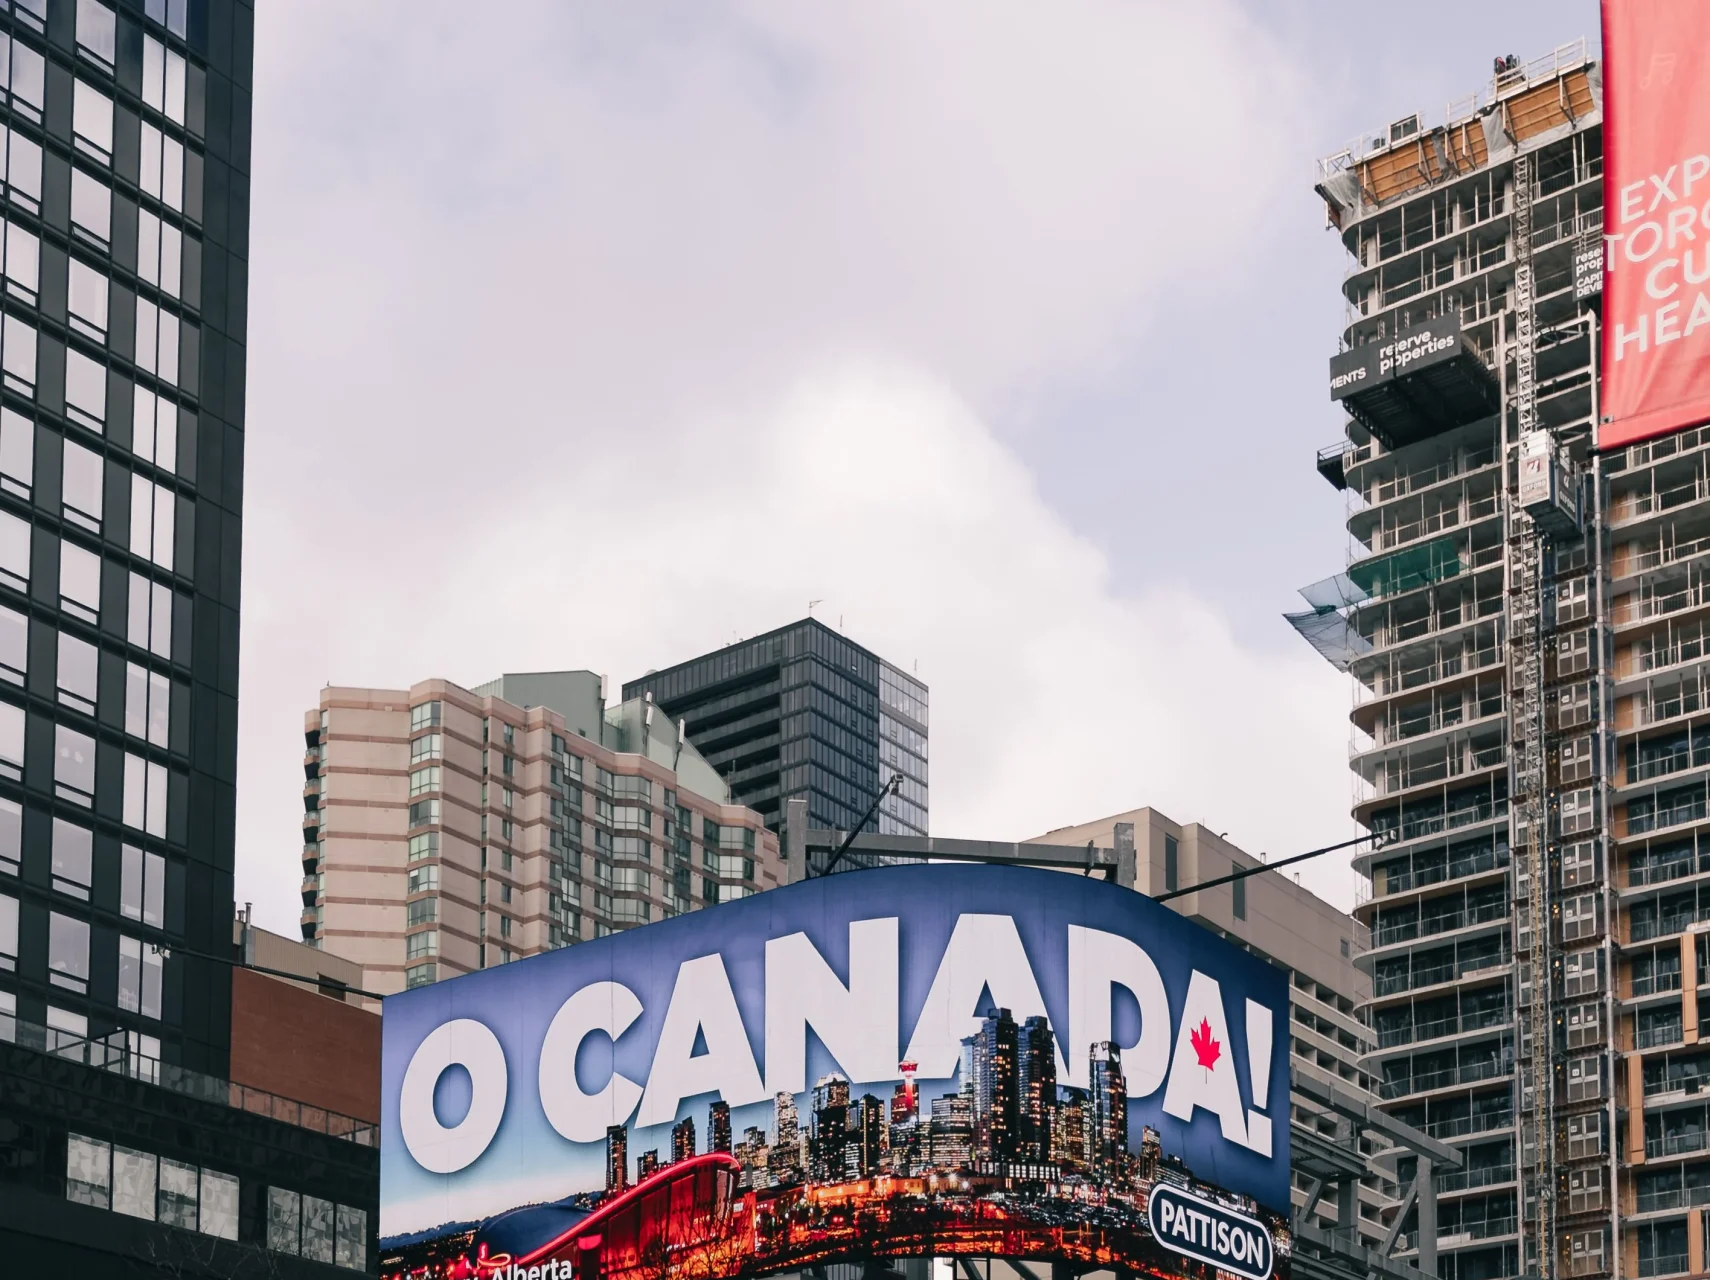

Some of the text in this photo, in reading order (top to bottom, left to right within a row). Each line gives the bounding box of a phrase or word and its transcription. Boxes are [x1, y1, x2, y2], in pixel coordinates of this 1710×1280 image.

[1380, 331, 1431, 359] reerve
[399, 913, 1274, 1175] O CANADA!
[1161, 1198, 1264, 1270] PATTISON
